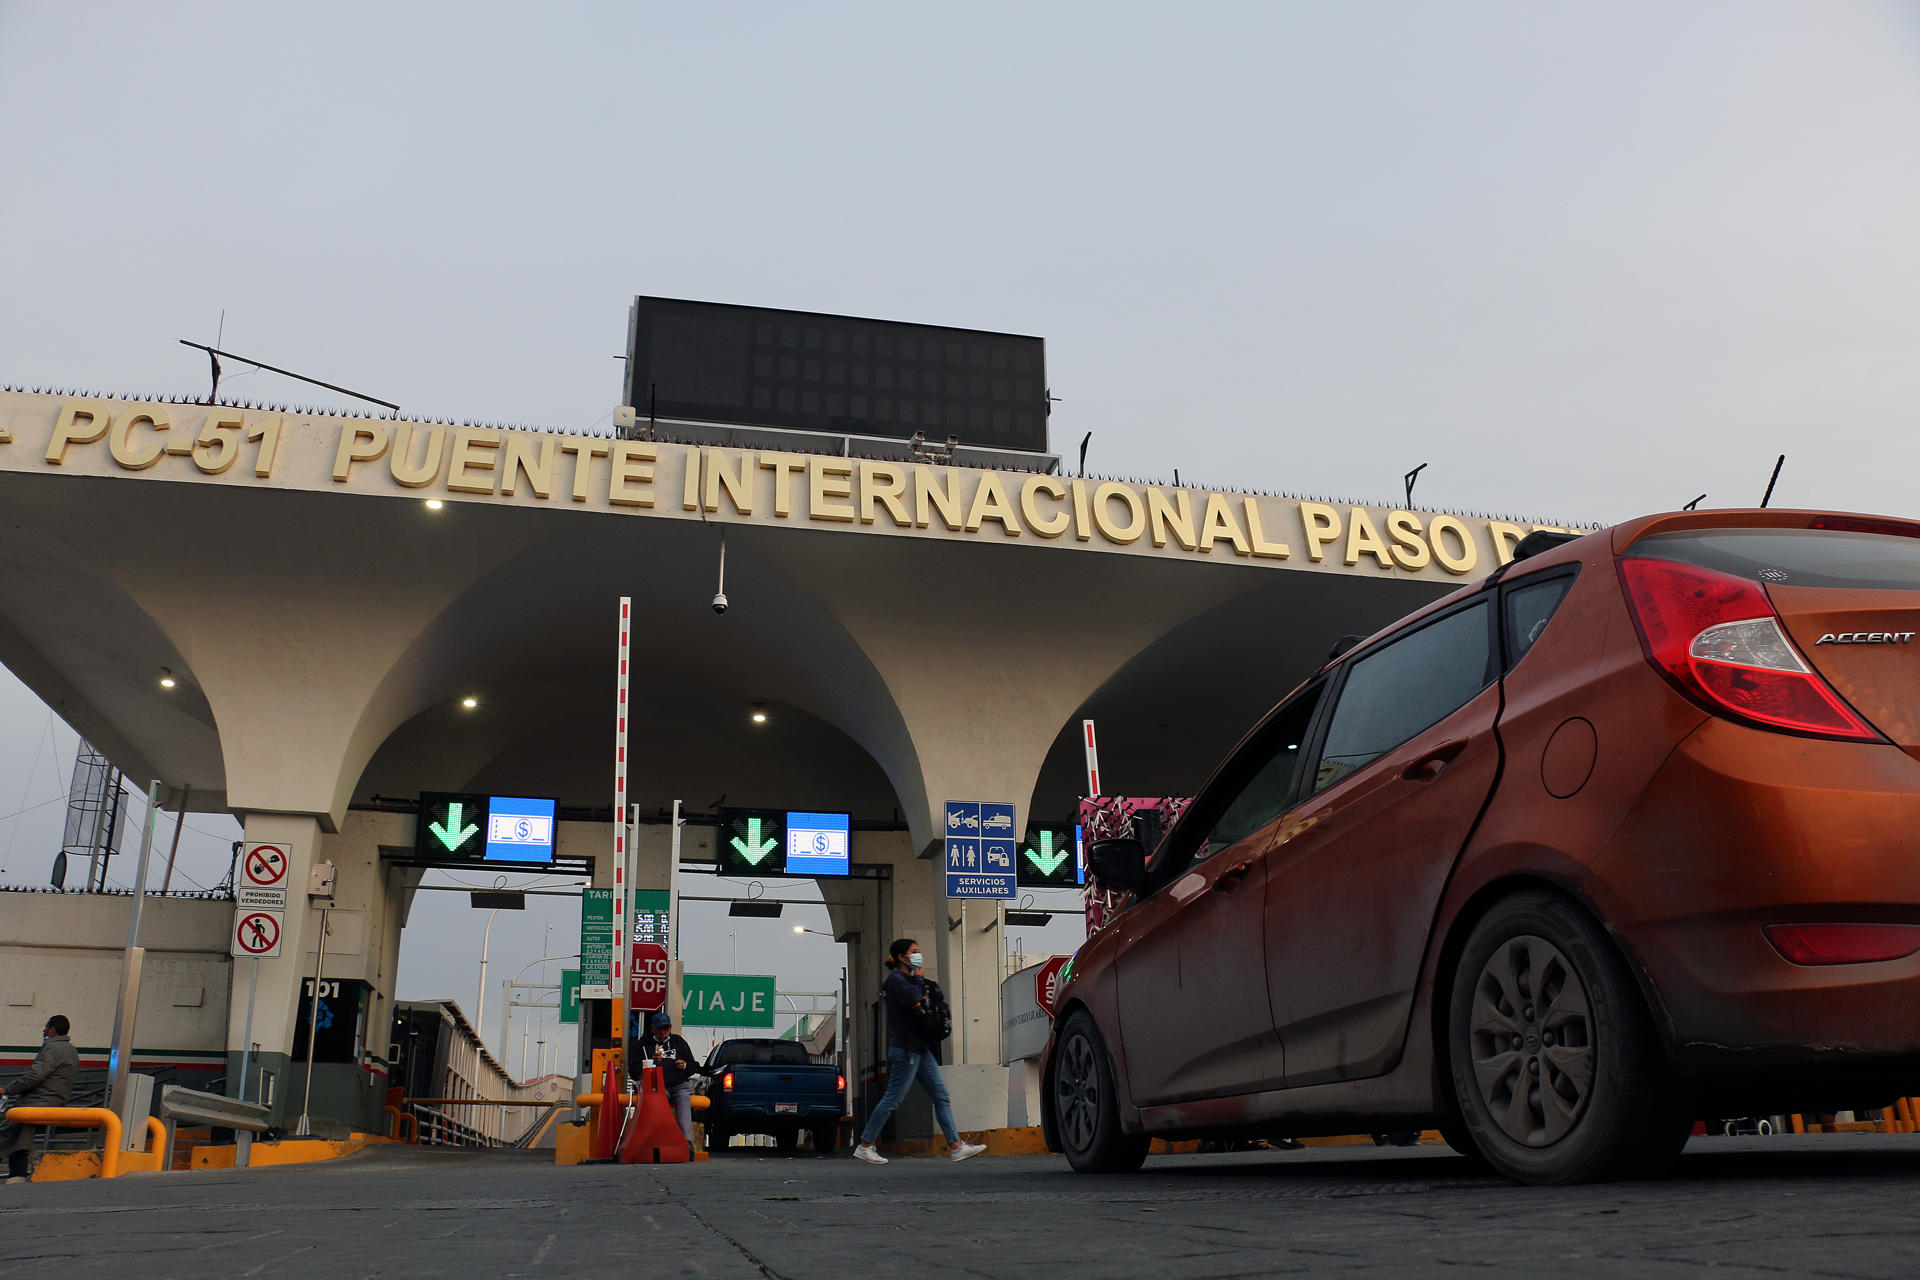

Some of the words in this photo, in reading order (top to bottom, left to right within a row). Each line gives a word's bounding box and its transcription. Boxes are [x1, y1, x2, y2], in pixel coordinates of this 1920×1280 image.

[44, 403, 283, 478] PC-51
[332, 419, 657, 508] PUENTE
[683, 446, 1290, 559] INTERNACIONAL
[1298, 502, 1476, 575] PASO
[1815, 632, 1916, 645] ACCENT
[959, 877, 1006, 886] SERVICIOS
[956, 886, 1009, 895] AUXILIARES
[241, 897, 284, 905] VENDEDORES
[632, 958, 667, 974] LTO
[306, 980, 340, 998] 101
[632, 977, 666, 993] TOP
